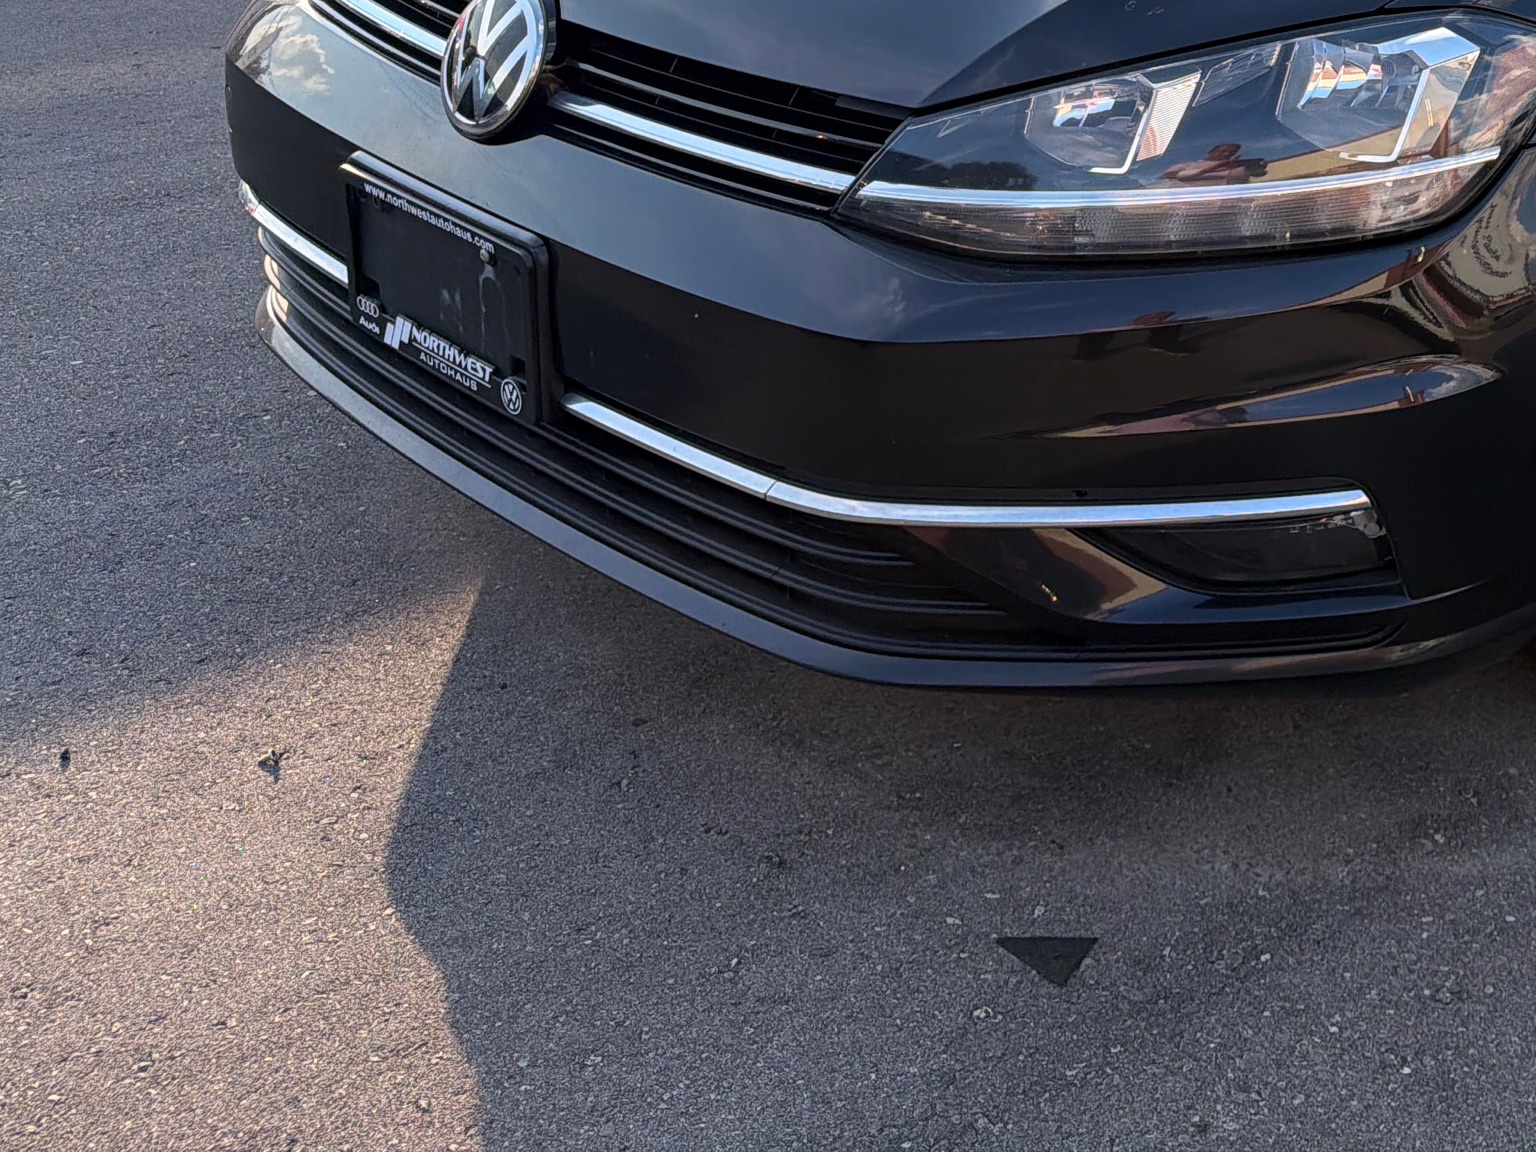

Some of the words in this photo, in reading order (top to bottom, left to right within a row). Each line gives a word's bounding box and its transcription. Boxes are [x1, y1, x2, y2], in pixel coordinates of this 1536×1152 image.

[363, 182, 495, 254] www.northwestautohaus.com
[359, 315, 380, 335] Audi
[411, 325, 493, 383] NORTHWEST
[419, 352, 479, 392] AUTOHAUS
